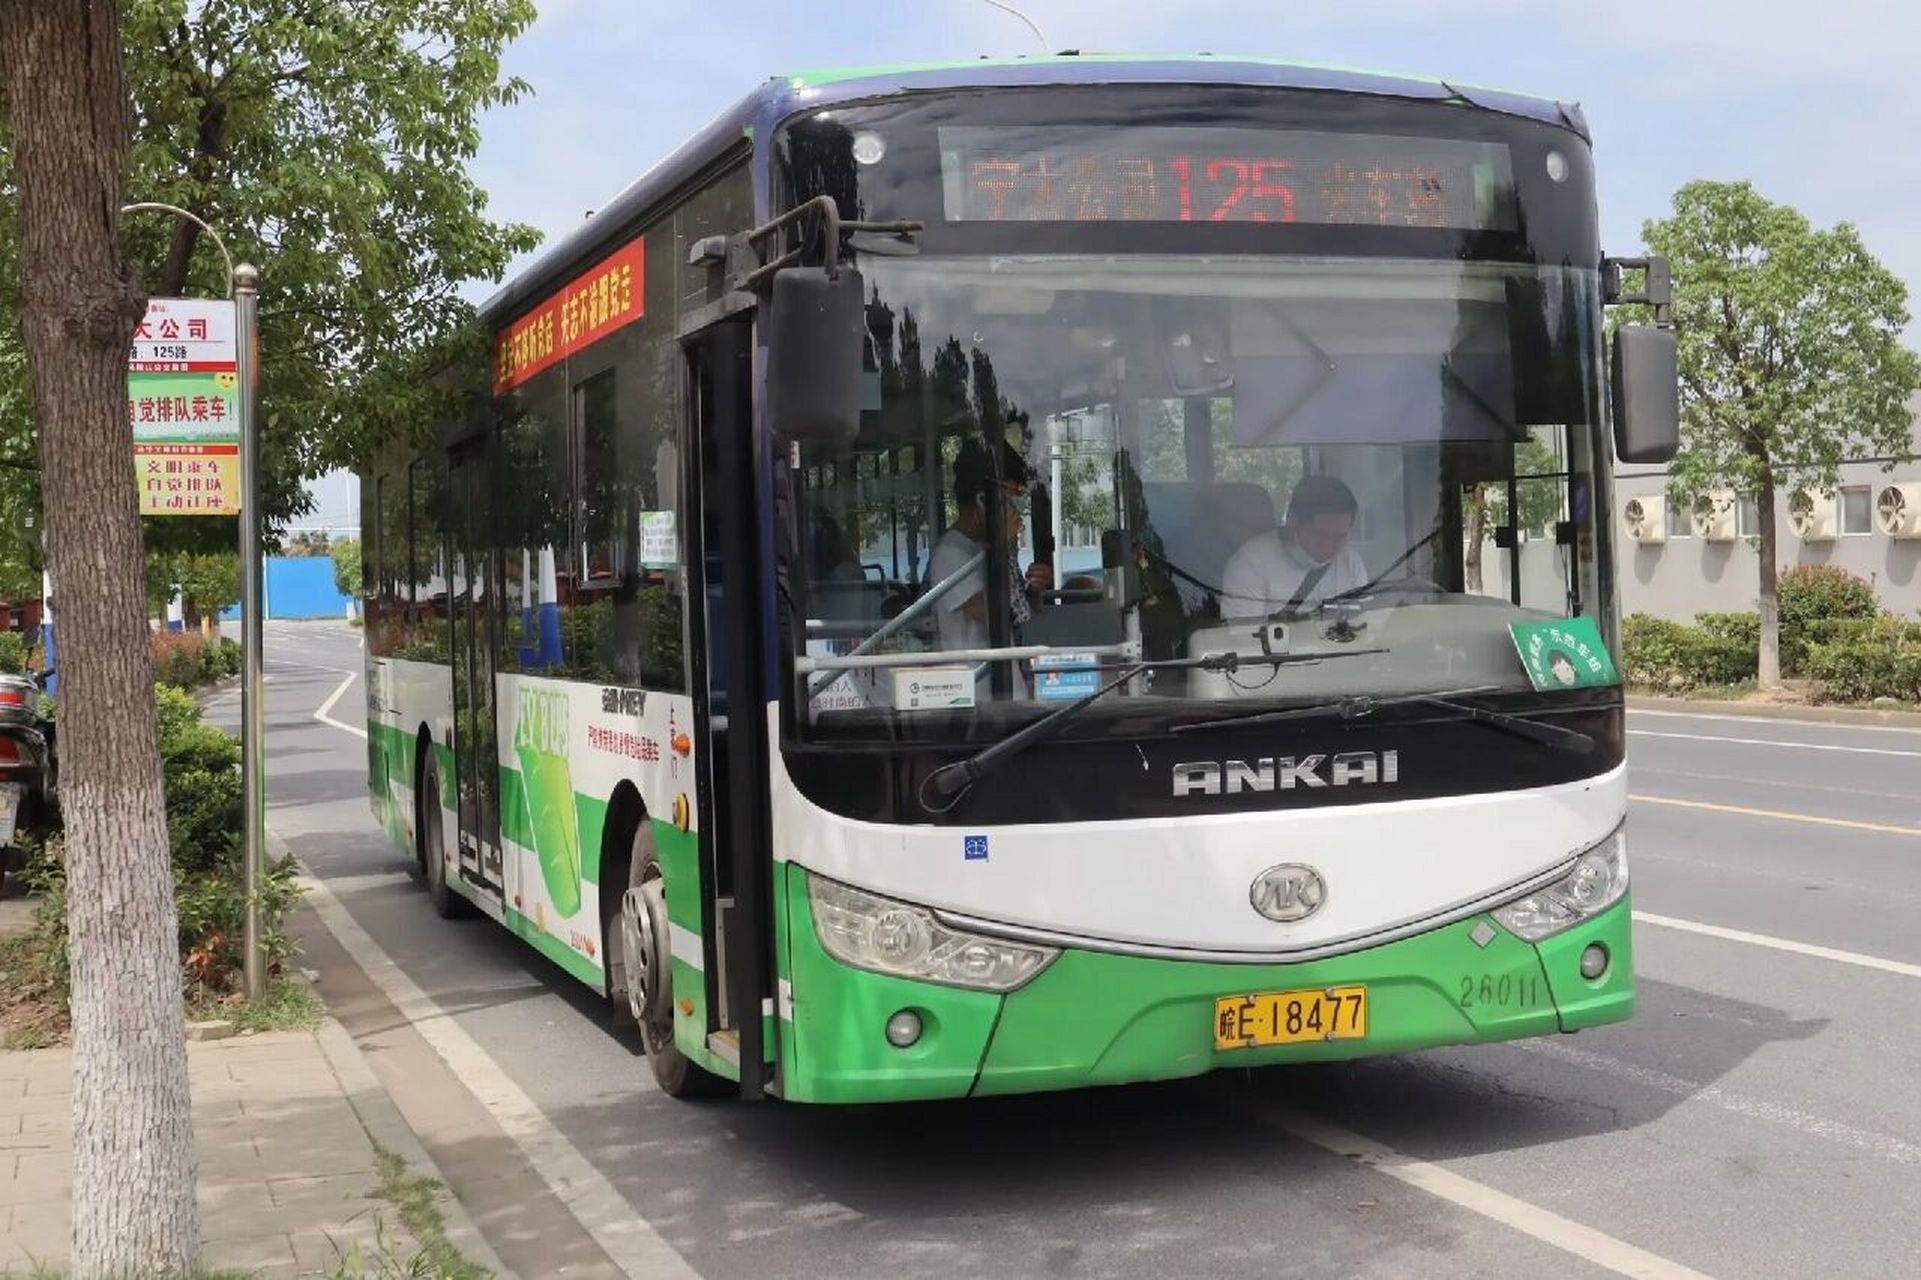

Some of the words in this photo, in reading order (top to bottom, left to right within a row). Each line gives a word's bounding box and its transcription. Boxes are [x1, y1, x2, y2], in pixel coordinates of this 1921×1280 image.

[1169, 156, 1297, 222] 125
[153, 346, 187, 359] 125路
[1172, 750, 1398, 797] ANKAI
